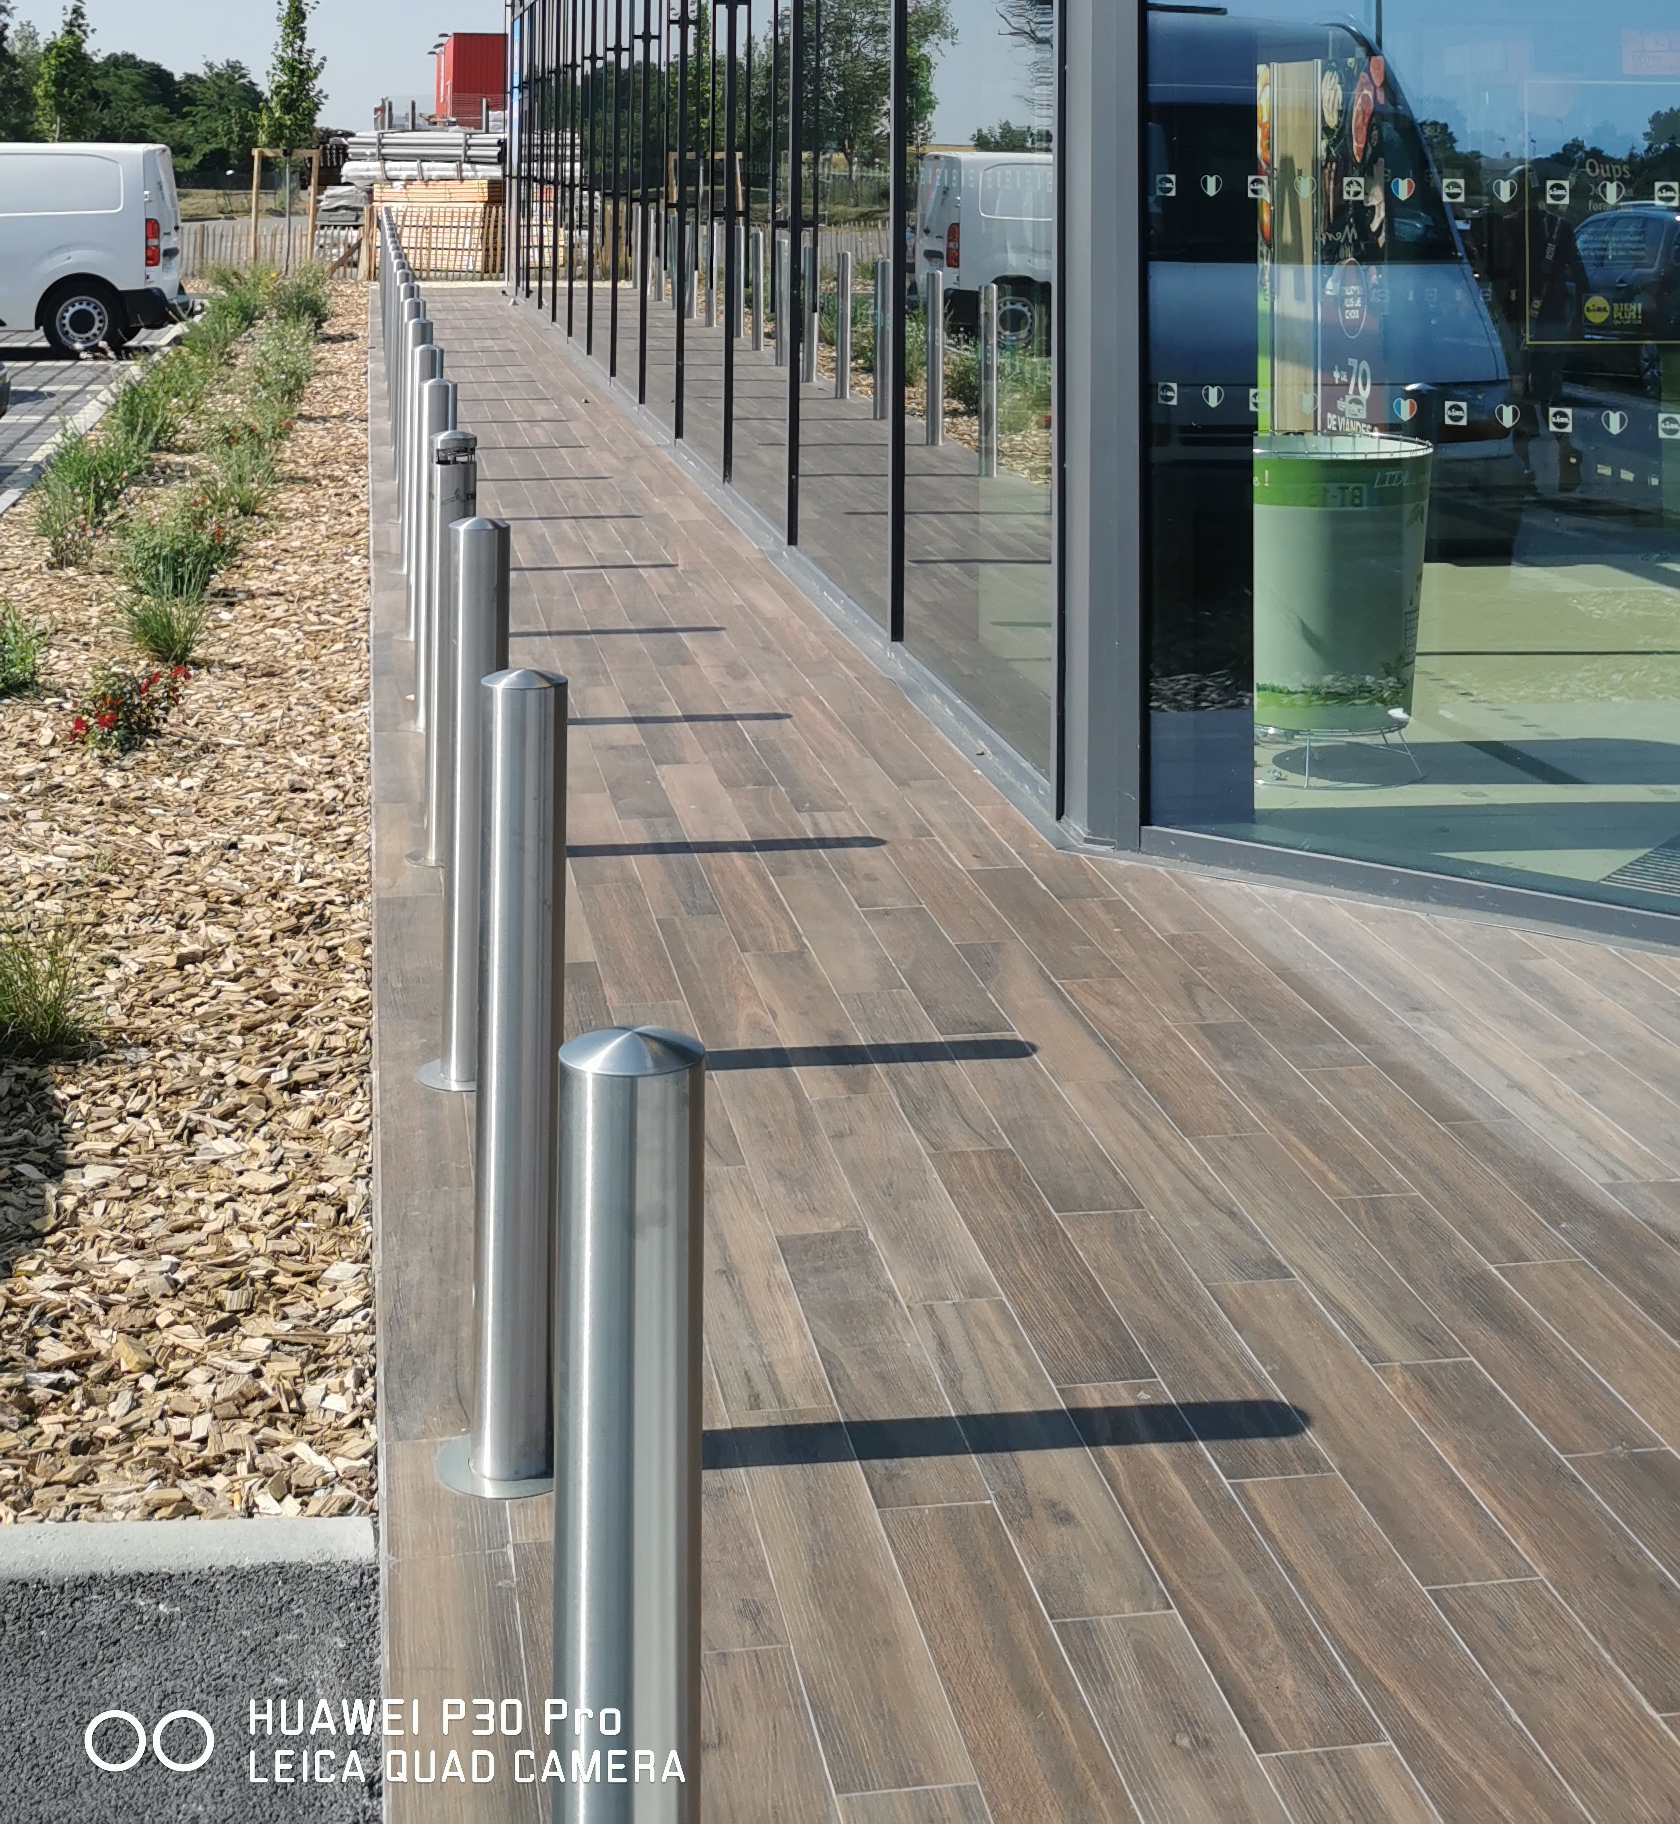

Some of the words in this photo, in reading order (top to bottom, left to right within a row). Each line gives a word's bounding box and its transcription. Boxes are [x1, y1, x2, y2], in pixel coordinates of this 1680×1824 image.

[1585, 157, 1632, 180] Oups
[1347, 357, 1372, 399] 70
[1327, 411, 1337, 431] DE
